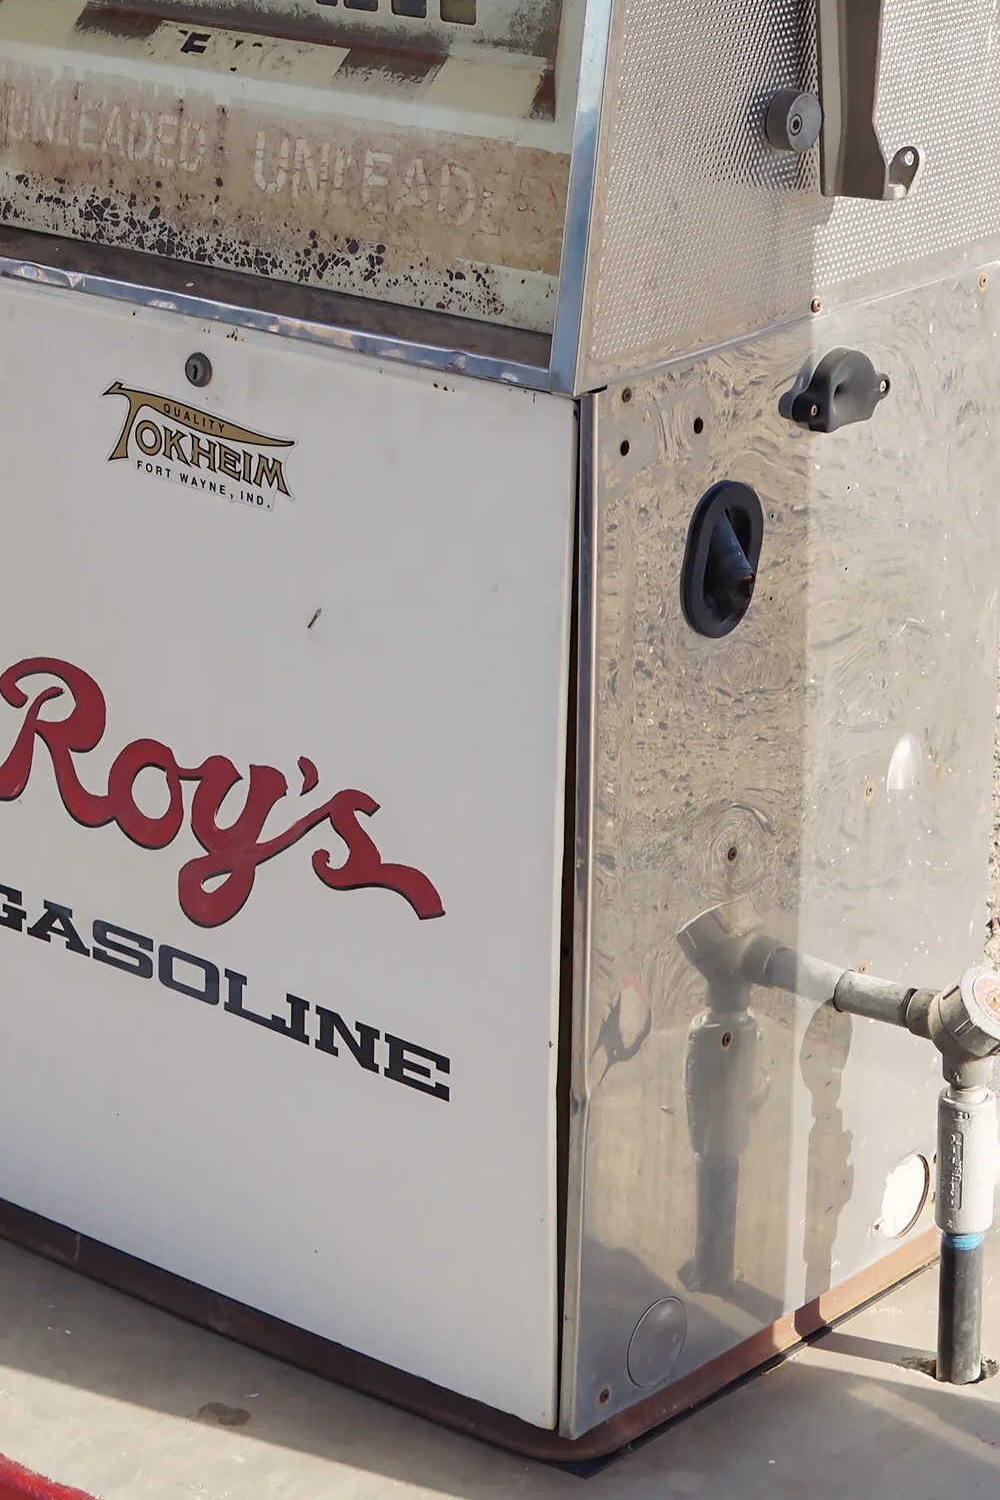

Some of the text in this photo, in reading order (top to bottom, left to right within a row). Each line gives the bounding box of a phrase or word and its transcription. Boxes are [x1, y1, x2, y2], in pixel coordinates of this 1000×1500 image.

[6, 85, 512, 238] UNLEADED UNLEAD
[102, 381, 296, 498] TOKHEIM
[163, 403, 225, 433] QUALITY
[137, 460, 271, 509] FORT WAYNE, IND.
